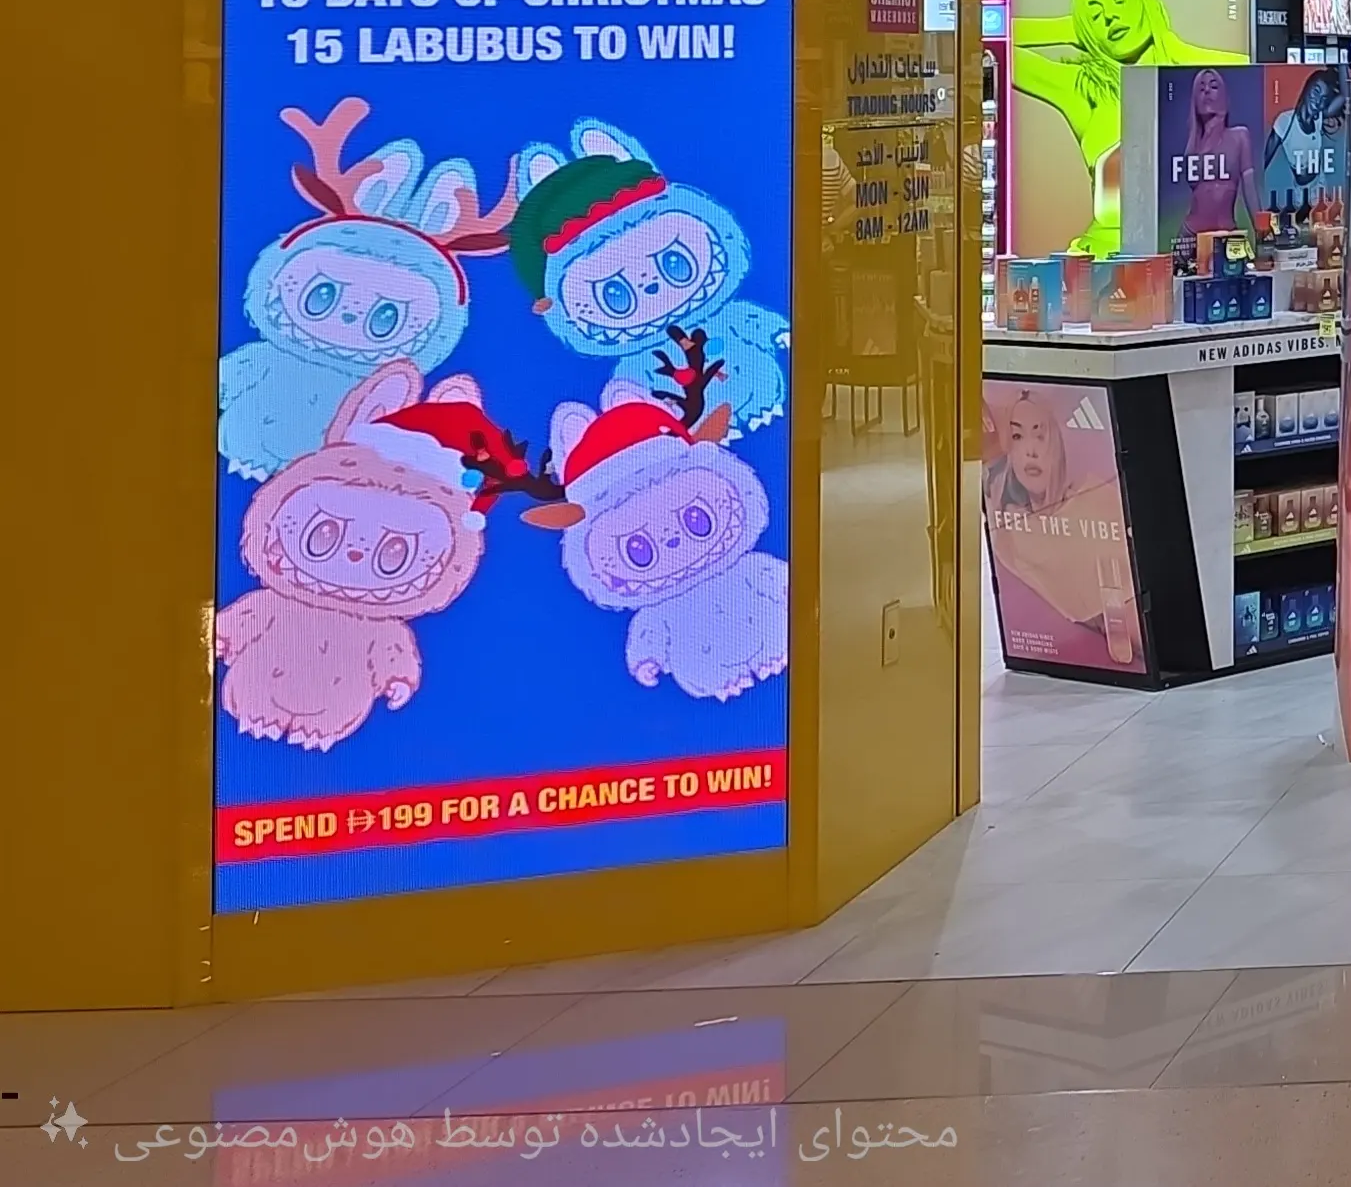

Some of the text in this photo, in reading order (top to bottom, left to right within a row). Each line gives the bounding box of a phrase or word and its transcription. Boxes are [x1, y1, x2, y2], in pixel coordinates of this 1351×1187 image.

[870, 8, 918, 25] WAREHOUSE
[287, 24, 735, 64] 15 LABUBUS TO WIN!
[847, 53, 892, 85] التداول
[847, 92, 936, 117] TRADING HOURS
[1172, 153, 1231, 183] FEEL
[1293, 148, 1335, 175] THE
[856, 180, 888, 209] MON
[903, 176, 930, 202] SUN
[898, 209, 929, 235] 12AM
[1199, 336, 1329, 362] NEW ADIDAS VIBES.
[994, 510, 1121, 541] FEEL THE VIBE
[234, 812, 337, 847] SPEND
[440, 798, 500, 825] FOR
[508, 794, 530, 816] A
[537, 778, 657, 813] CHANCE
[663, 774, 700, 798] TO
[706, 764, 773, 794] WIN!
